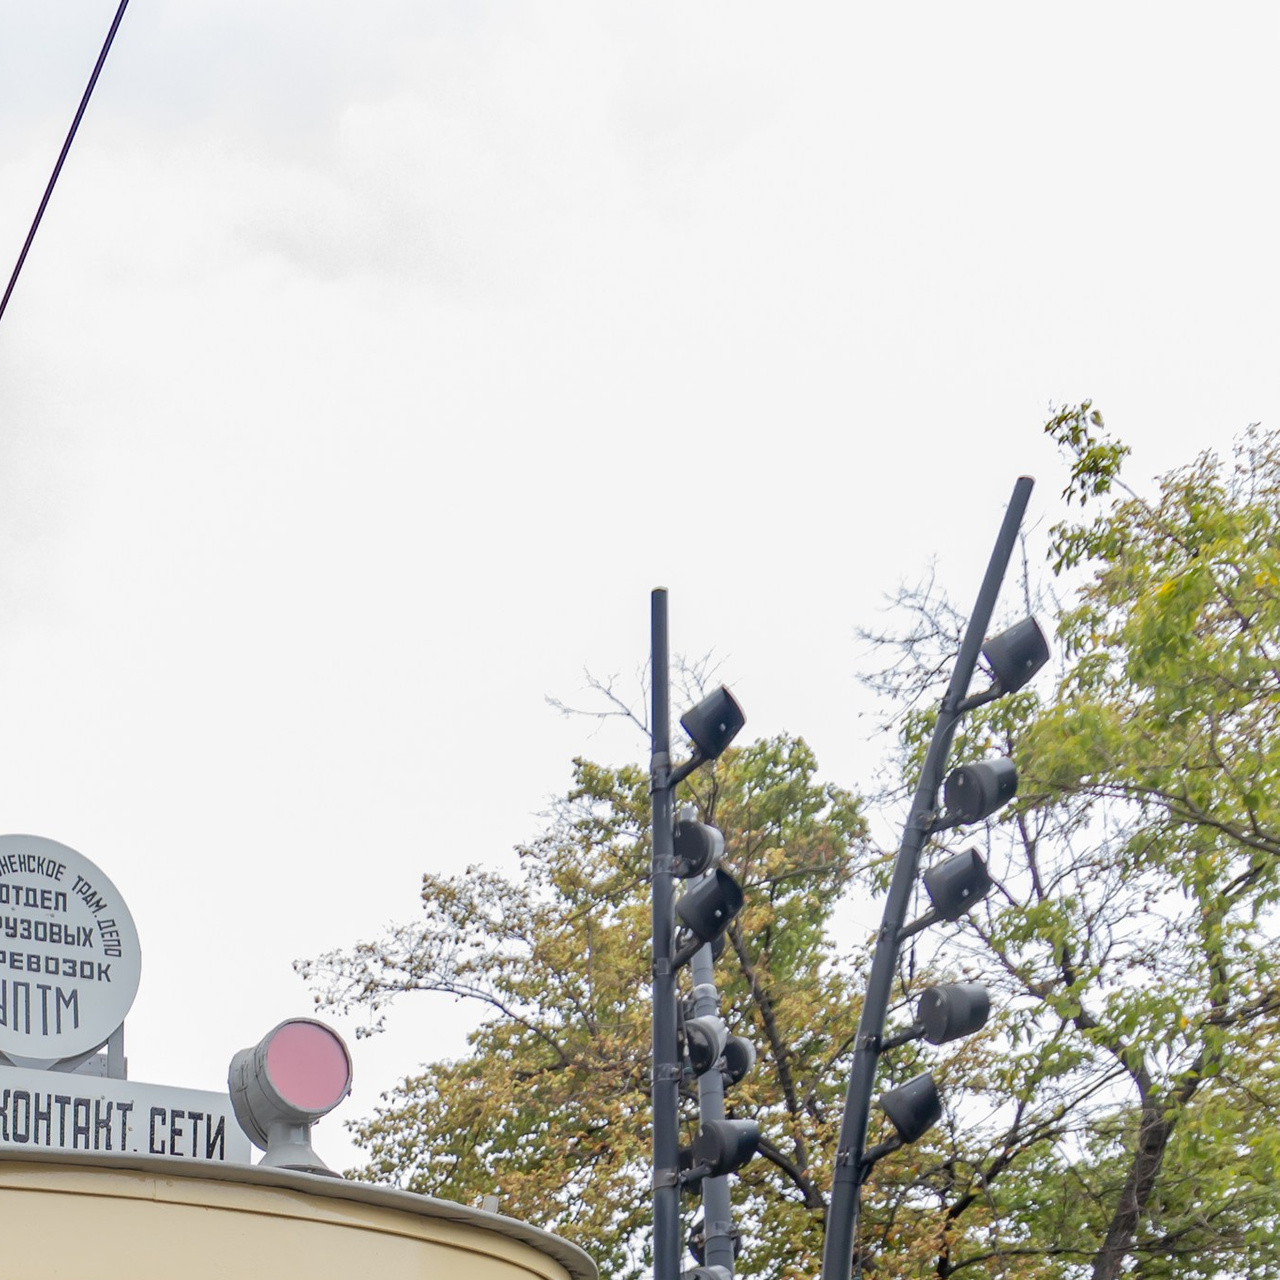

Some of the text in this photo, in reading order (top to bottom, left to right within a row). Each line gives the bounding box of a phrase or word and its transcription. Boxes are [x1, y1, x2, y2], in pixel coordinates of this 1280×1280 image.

[71, 874, 108, 918] ТРАМ.
[96, 918, 122, 958] ДЕПО
[149, 1106, 226, 1161] СЕТИ
